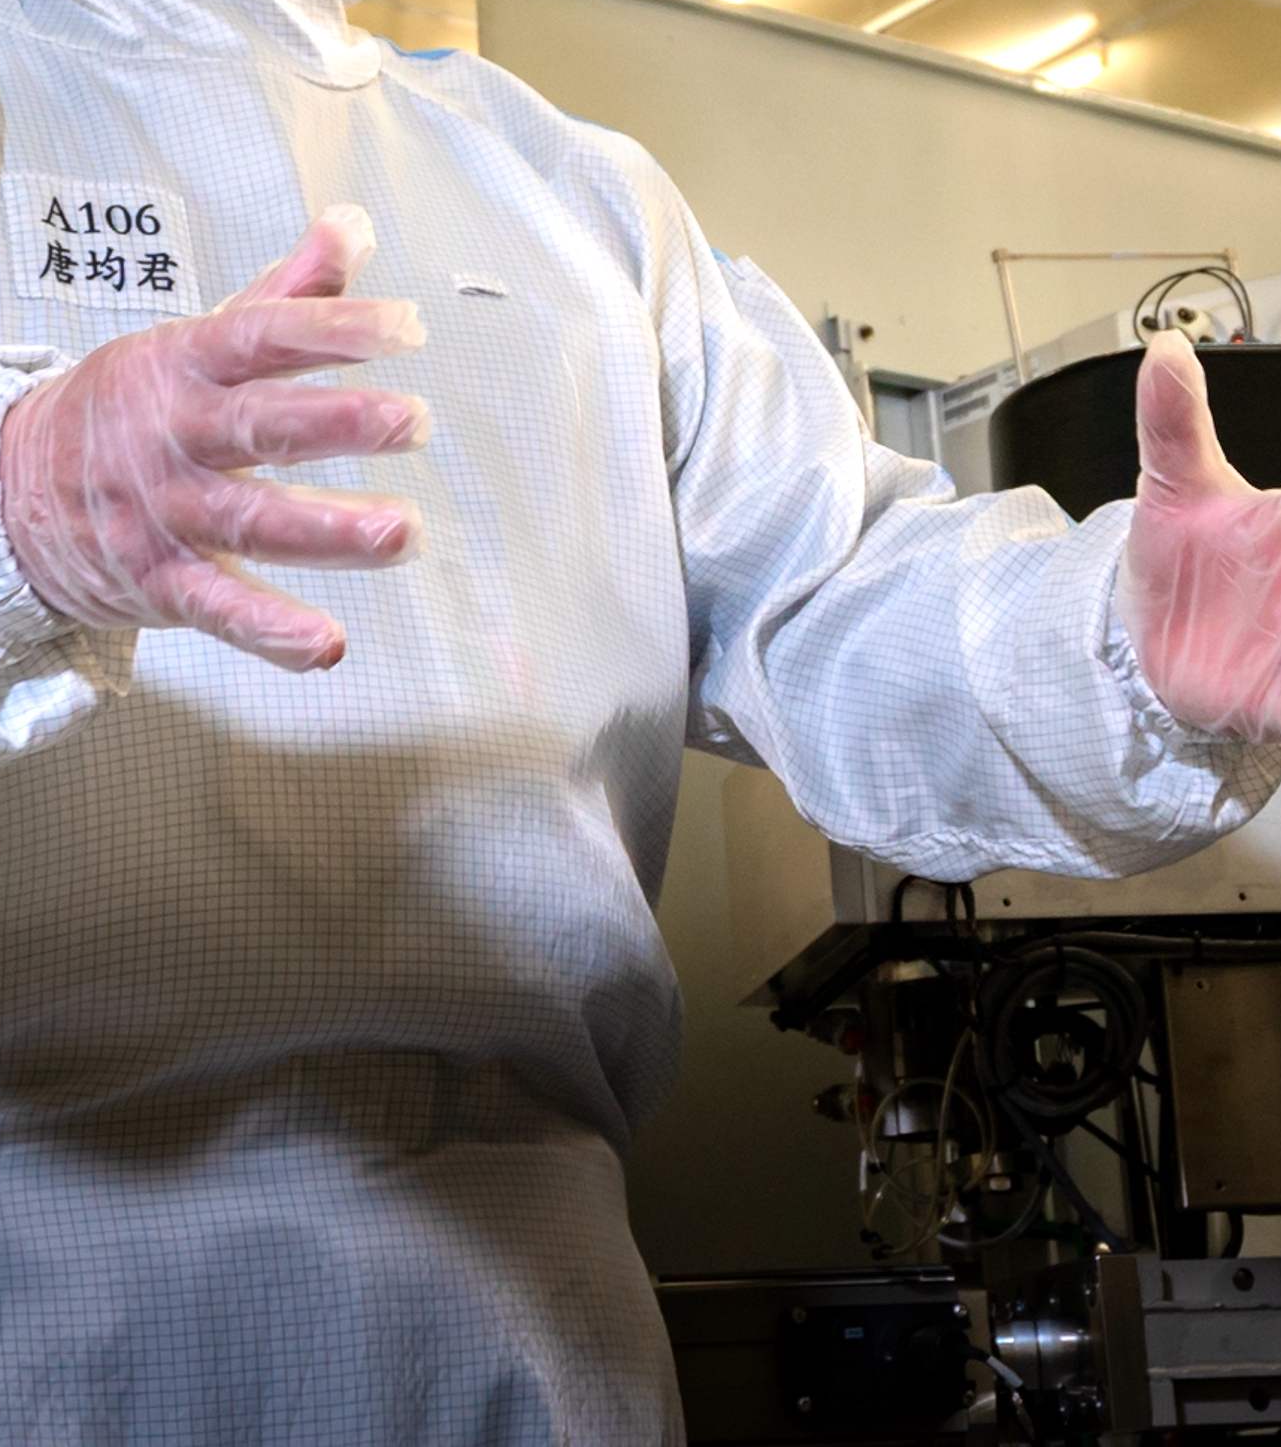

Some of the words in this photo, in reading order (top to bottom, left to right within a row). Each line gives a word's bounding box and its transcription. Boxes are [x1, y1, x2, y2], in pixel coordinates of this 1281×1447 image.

[41, 195, 161, 236] A106
[39, 239, 179, 293] 唐均君
